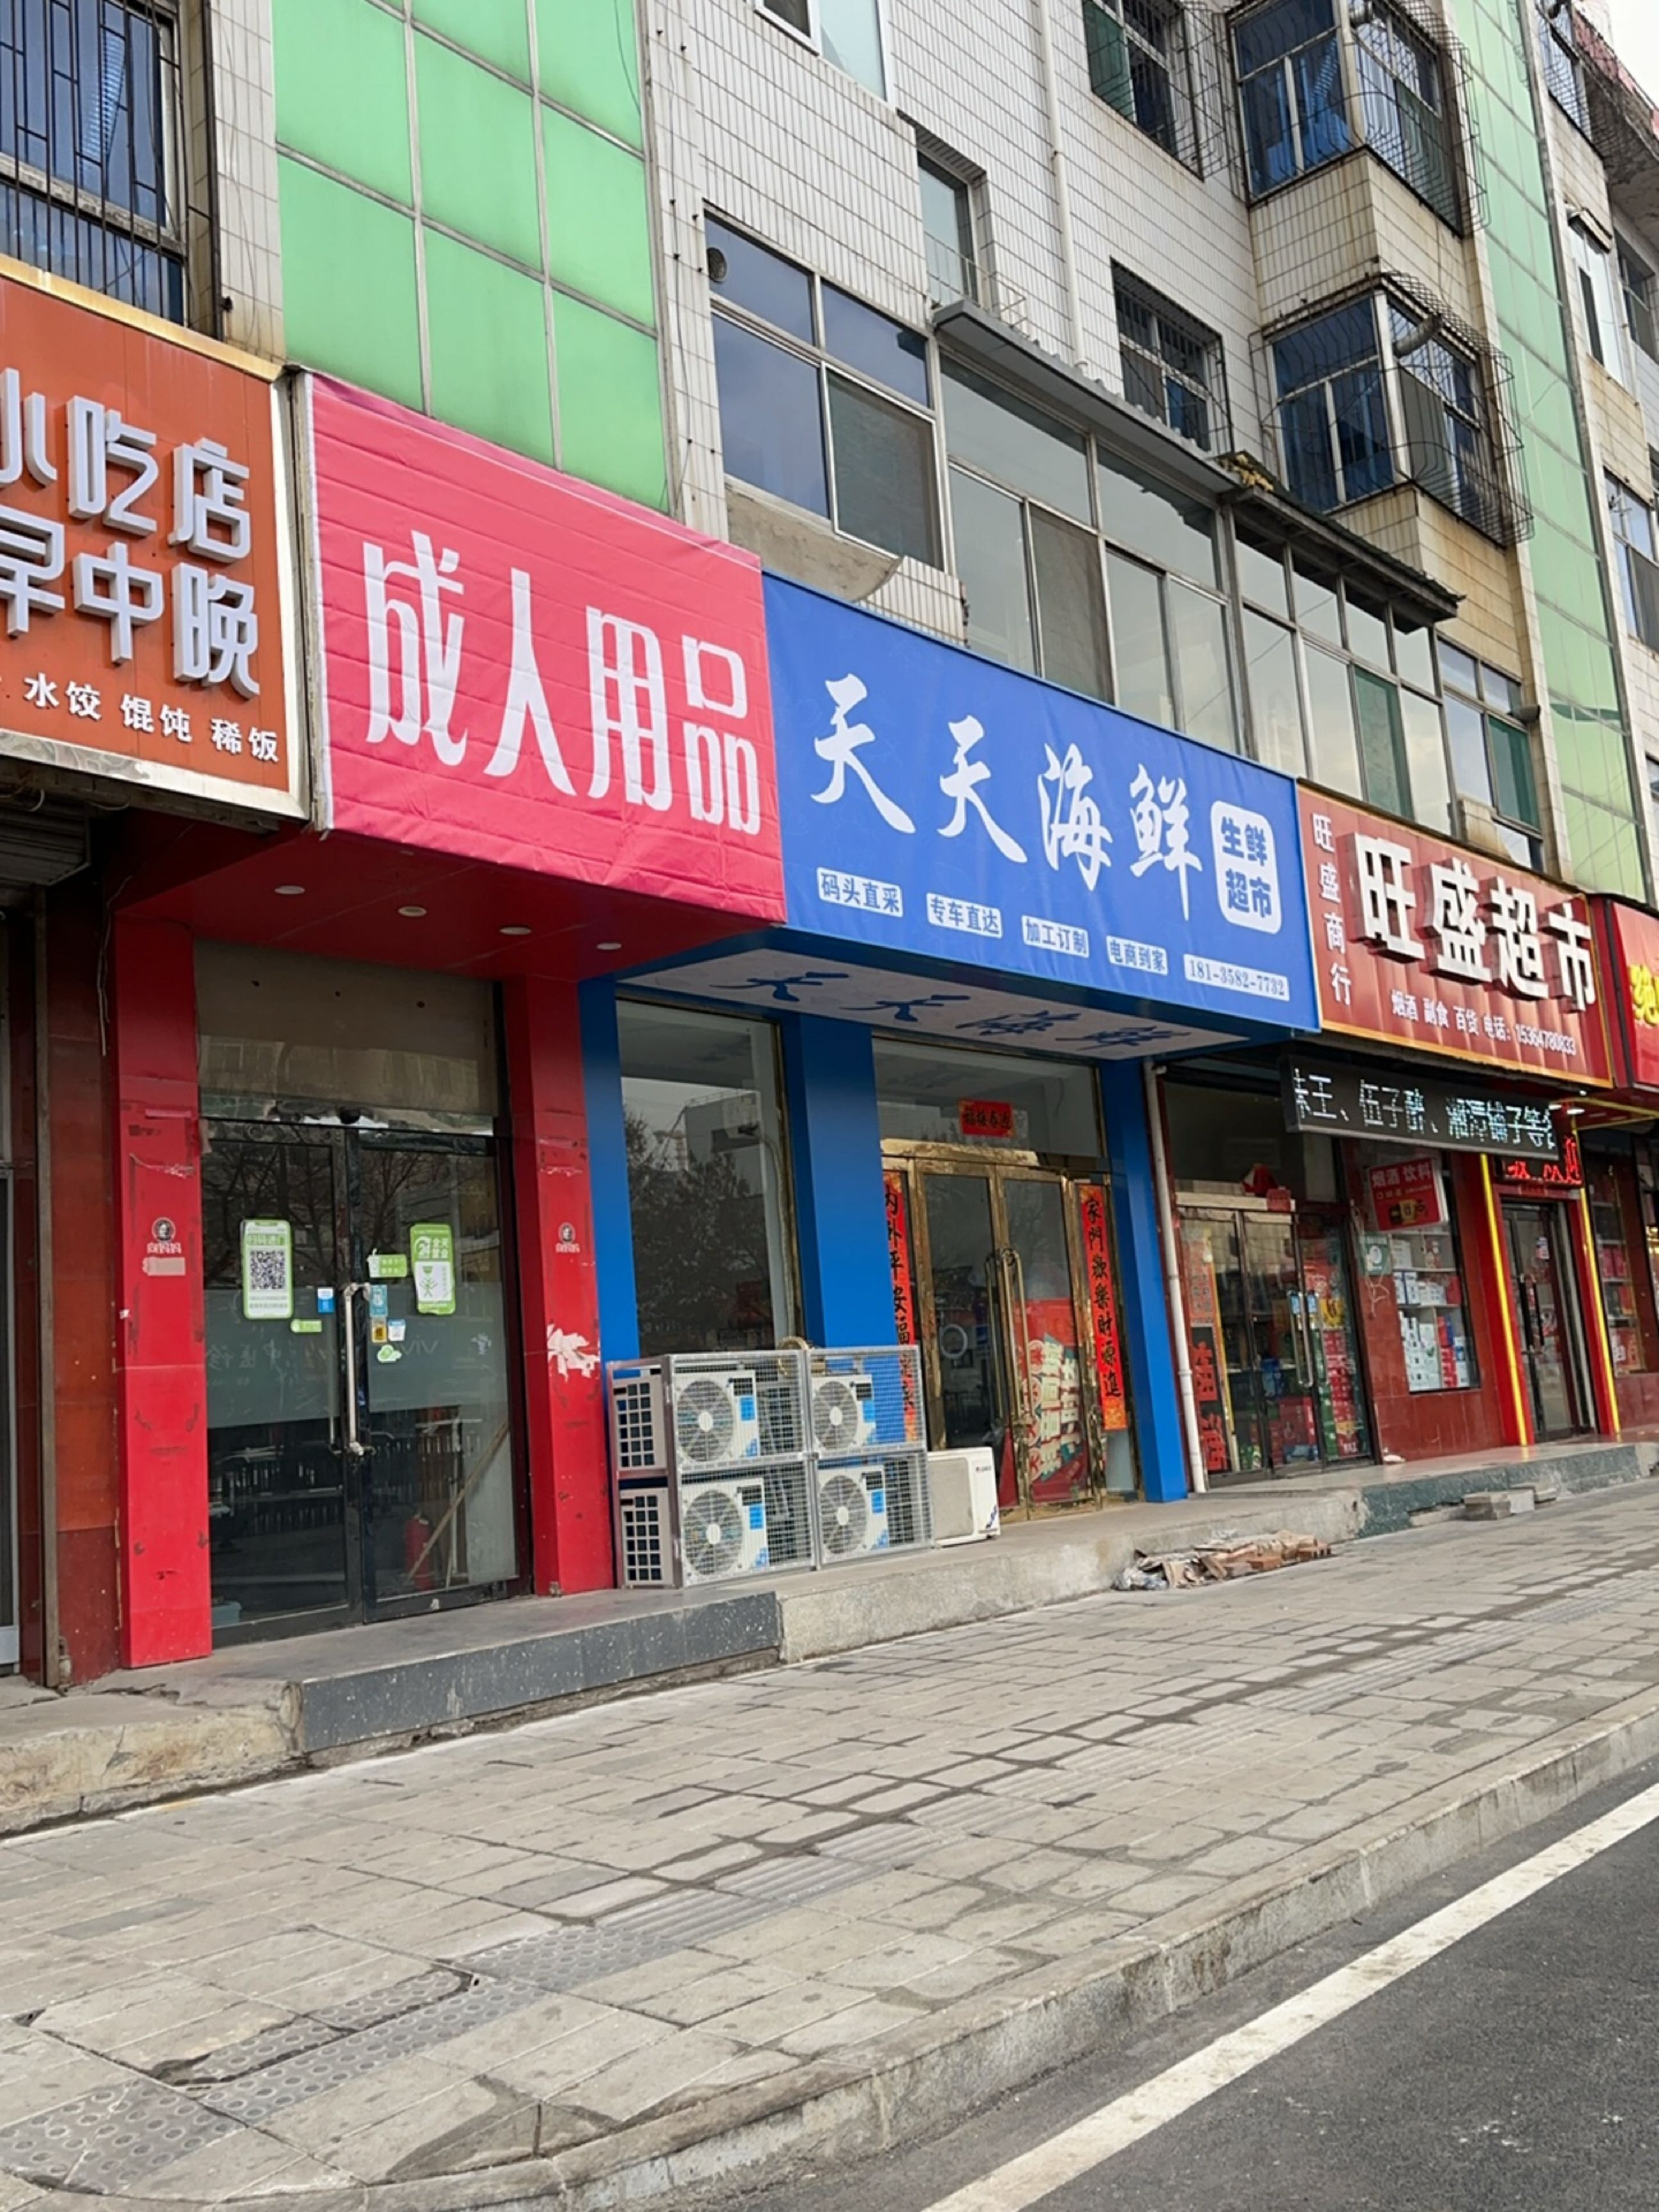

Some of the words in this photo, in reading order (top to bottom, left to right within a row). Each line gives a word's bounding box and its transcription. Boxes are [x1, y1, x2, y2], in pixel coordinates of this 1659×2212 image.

[0, 506, 260, 698] 早中晚
[363, 529, 761, 835] 成人用品
[24, 673, 101, 721] 水饺
[120, 694, 193, 743] 馄饨
[211, 718, 278, 762] 稀饭
[810, 673, 1203, 922] 天天海鲜
[1220, 816, 1269, 867] 生鲜
[821, 872, 901, 914] 码头直采
[929, 897, 1000, 936] 专车直达
[1223, 868, 1272, 920] 超市
[1313, 812, 1352, 1006] 旺盛商行
[1024, 920, 1089, 956] 加工订制
[1352, 833, 1596, 1011] 旺盛超市
[1109, 939, 1167, 973] 电商到家
[1190, 960, 1285, 996] 181-3582-7732
[1391, 990, 1418, 1021] 烟酒
[1423, 998, 1448, 1028] 副食
[1454, 1005, 1479, 1036] 百货
